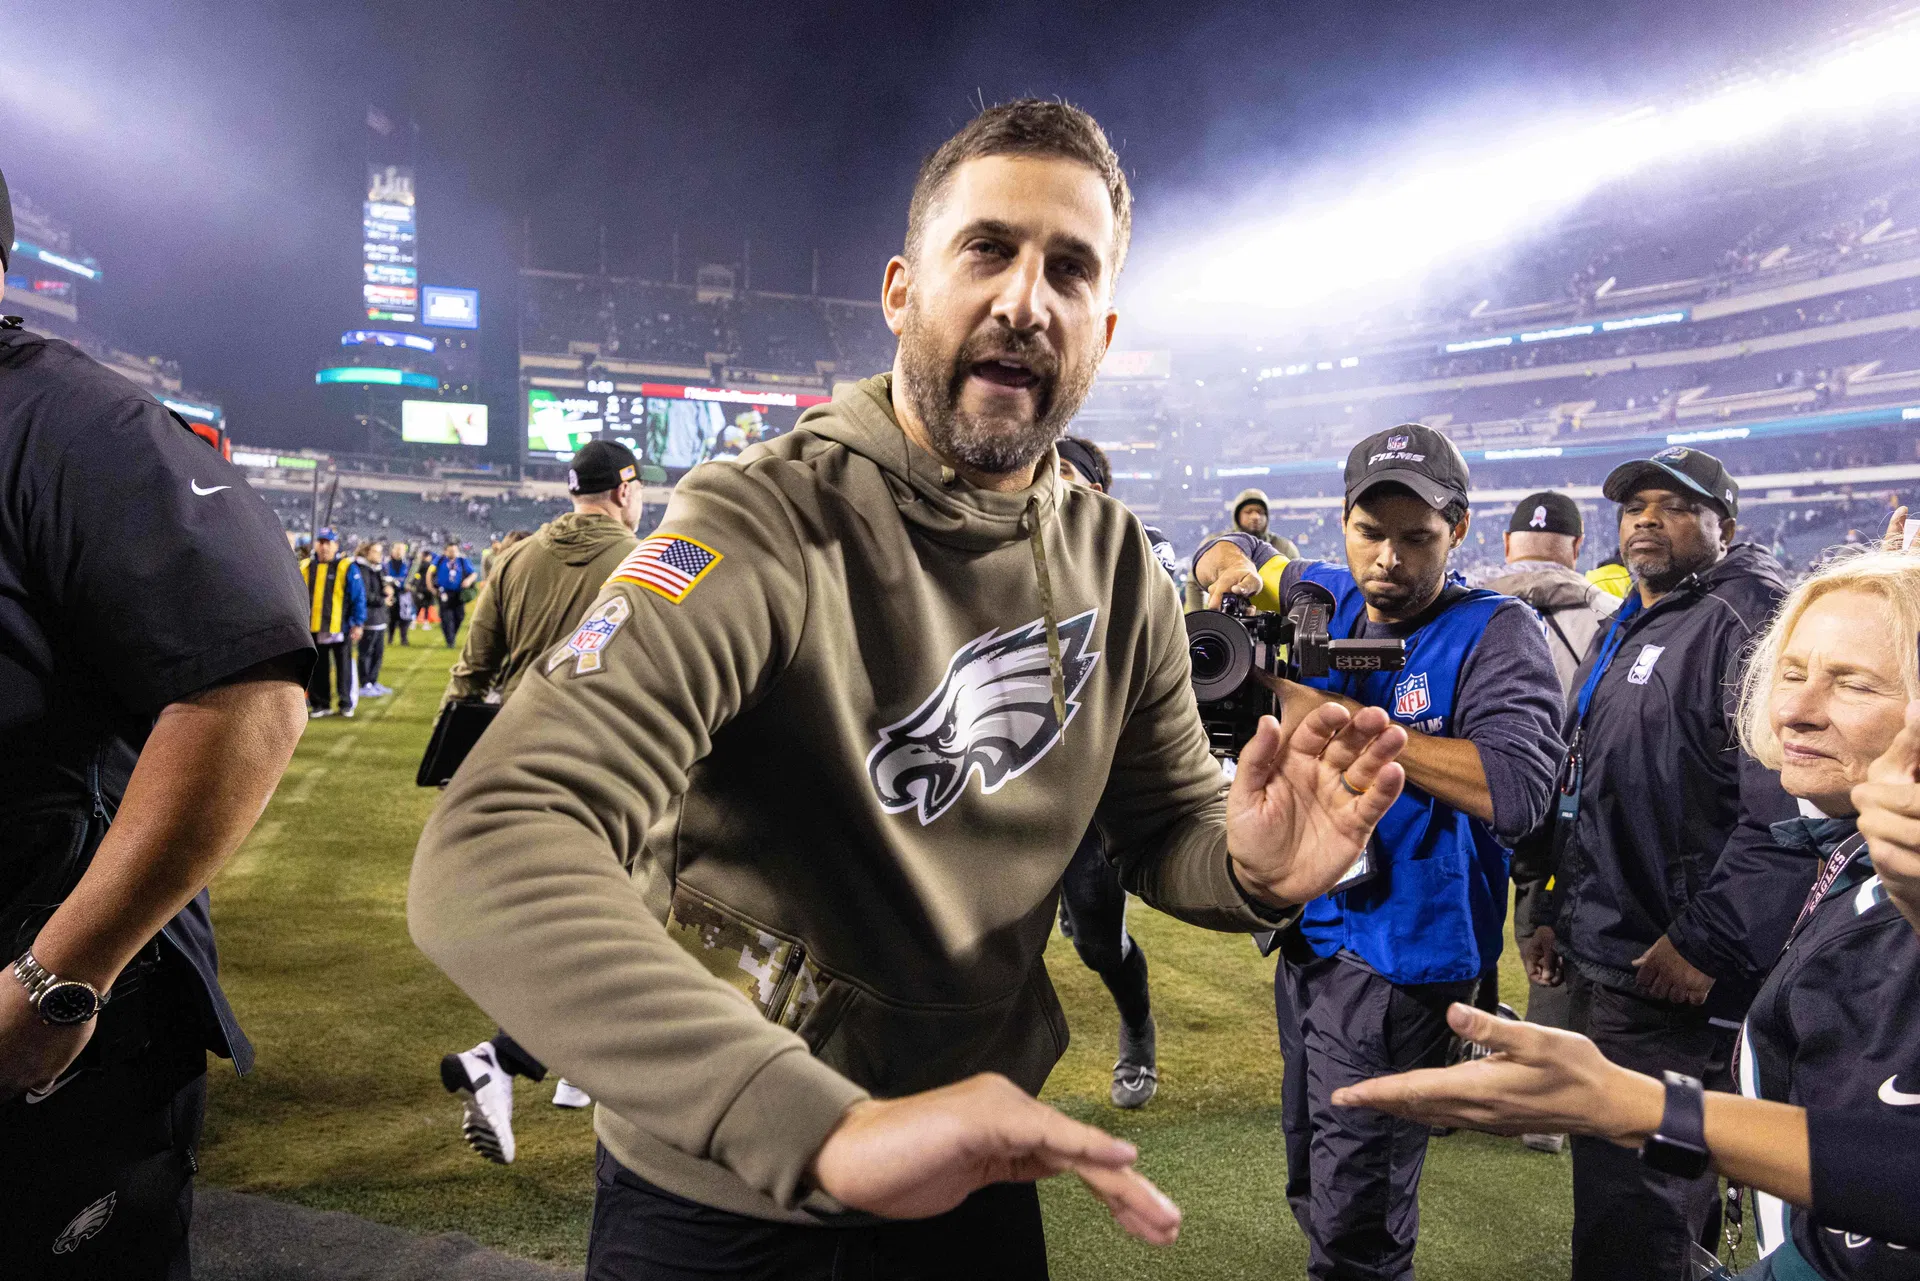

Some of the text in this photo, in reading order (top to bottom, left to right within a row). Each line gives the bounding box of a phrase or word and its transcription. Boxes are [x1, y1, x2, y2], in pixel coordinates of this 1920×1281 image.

[1367, 451, 1426, 466] FILMS
[573, 630, 604, 649] NFL
[1337, 656, 1380, 668] SDS
[1397, 690, 1426, 713] NFL
[1809, 850, 1847, 916] EAGLES
